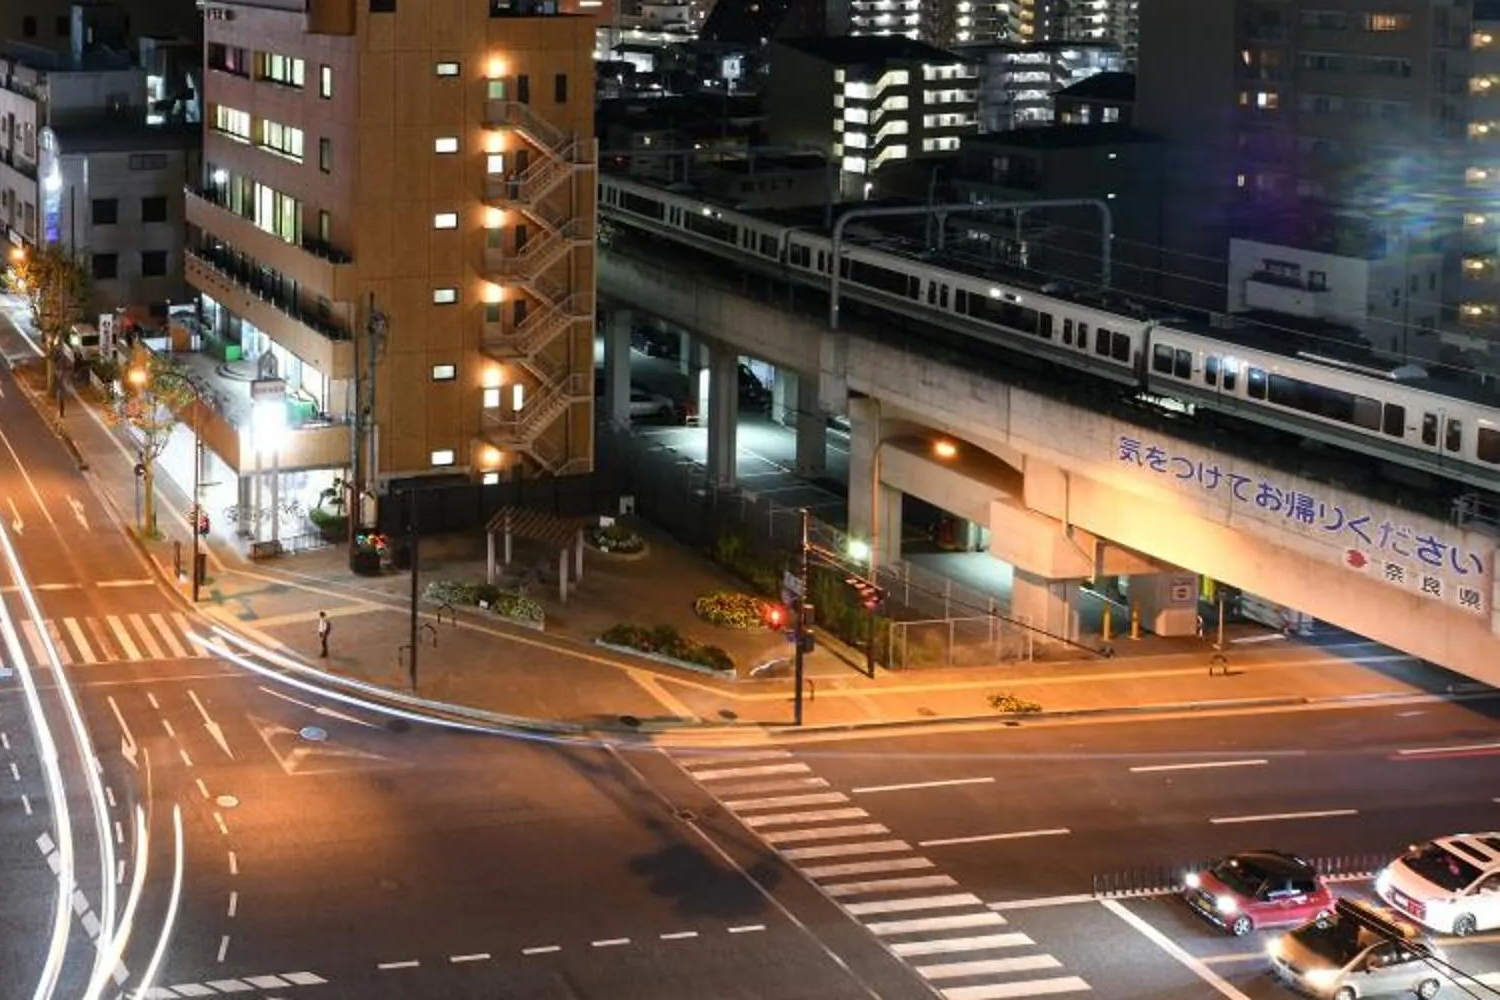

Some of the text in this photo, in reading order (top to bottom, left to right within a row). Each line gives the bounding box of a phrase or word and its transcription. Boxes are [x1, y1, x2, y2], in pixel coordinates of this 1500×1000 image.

[1119, 436, 1484, 575] 気をつけてお帰りください
[1384, 562, 1483, 611] 奈良県
